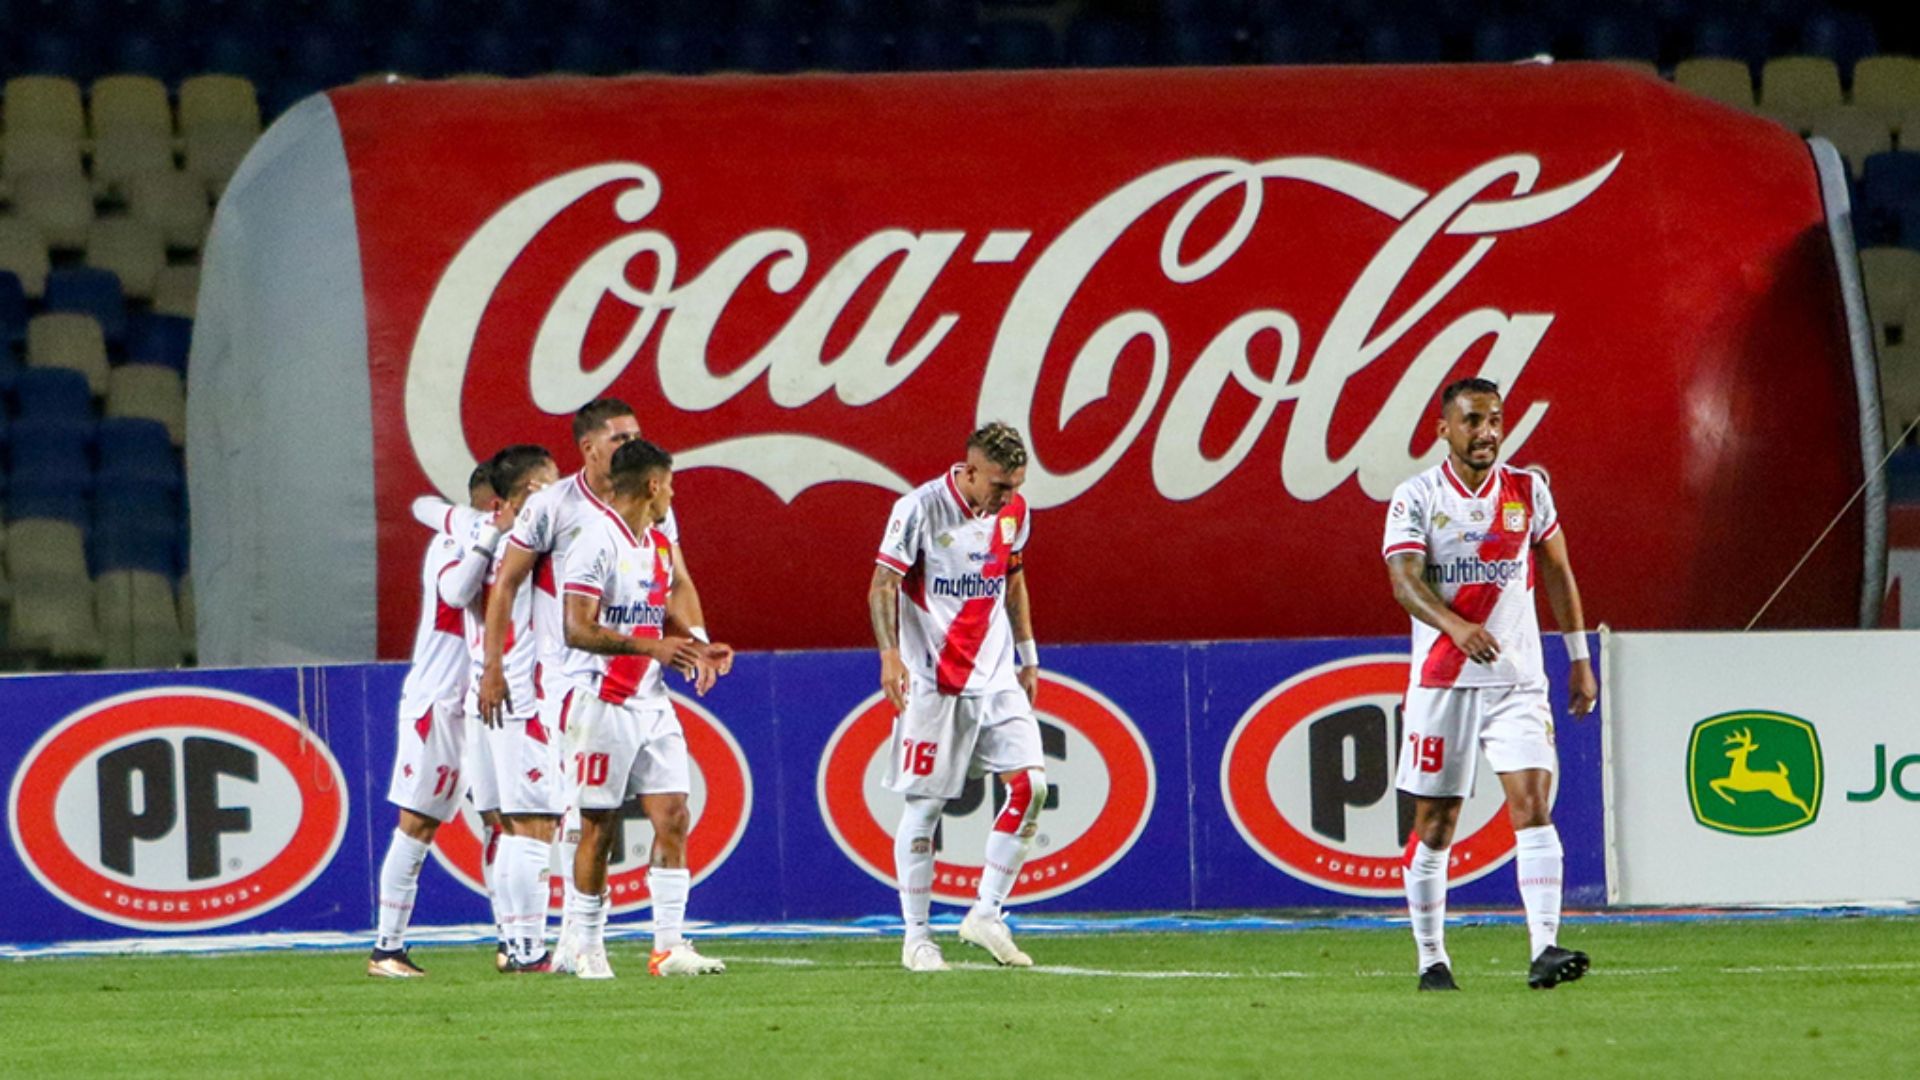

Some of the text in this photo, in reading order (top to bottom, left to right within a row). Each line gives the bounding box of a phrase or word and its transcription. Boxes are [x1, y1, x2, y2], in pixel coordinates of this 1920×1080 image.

[405, 152, 1623, 509] Coca-Cola
[1427, 557, 1523, 587] multihogar
[574, 752, 611, 786] 10
[903, 741, 938, 776] 16
[1408, 732, 1445, 774] 19
[431, 764, 461, 801] 11
[97, 736, 258, 881] PF
[933, 872, 982, 887] ESD
[1018, 865, 1057, 885] 903
[1328, 860, 1401, 880] DESDE
[117, 888, 249, 913] DESDE 1903
